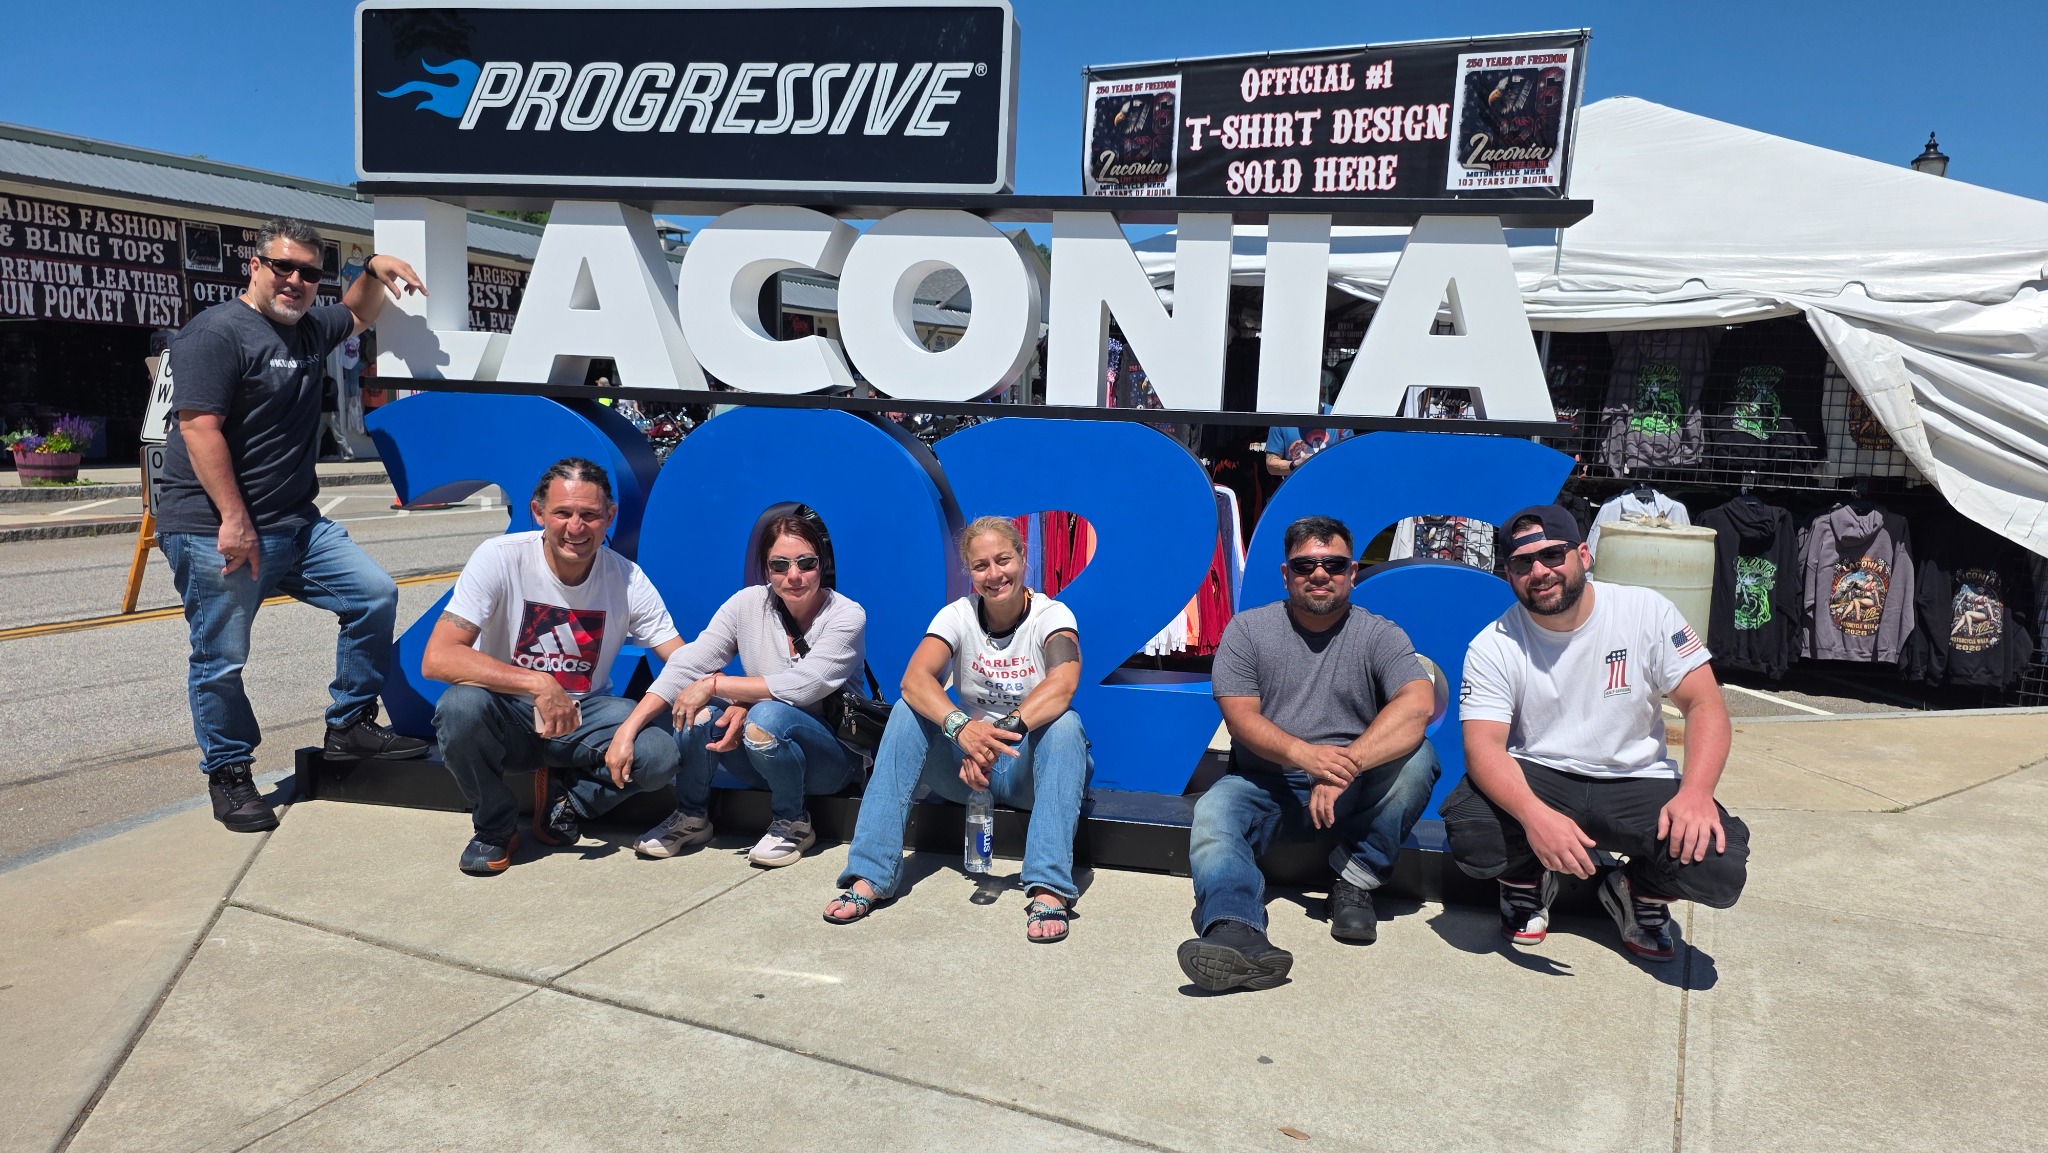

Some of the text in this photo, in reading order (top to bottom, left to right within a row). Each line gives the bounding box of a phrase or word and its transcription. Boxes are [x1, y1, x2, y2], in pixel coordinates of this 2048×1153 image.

[1466, 54, 1567, 68] 250 YEARS OF FREEDOM
[1112, 84, 1133, 94] YEARS
[1135, 83, 1143, 92] OF
[1145, 80, 1176, 91] FREEDOM
[1240, 58, 1393, 102] OFFICIAL #1
[1186, 103, 1451, 152] T-SHIRT DESIGN
[1096, 150, 1168, 183] Laconia
[1462, 133, 1553, 170] Laconia
[1226, 154, 1398, 195] SOLD HERE
[1477, 178, 1505, 186] YEARS
[1523, 176, 1553, 184] RIDING
[0, 197, 177, 241] ADIES FASHION
[0, 224, 165, 264] & BLING TOPS
[0, 257, 180, 295] REMIUM LEATHER
[0, 280, 182, 326] UN POCKET VEST
[374, 197, 1558, 421] LACONIA
[468, 282, 512, 310] EST
[490, 312, 516, 330] EVE
[1842, 561, 1883, 573] LACONIA
[517, 653, 592, 672] adidas
[1955, 643, 1983, 652] 2026
[971, 661, 1036, 679] DAVIDSON
[985, 680, 1024, 691] GRAB
[988, 690, 1022, 702] LIFE
[983, 818, 993, 853] smart
